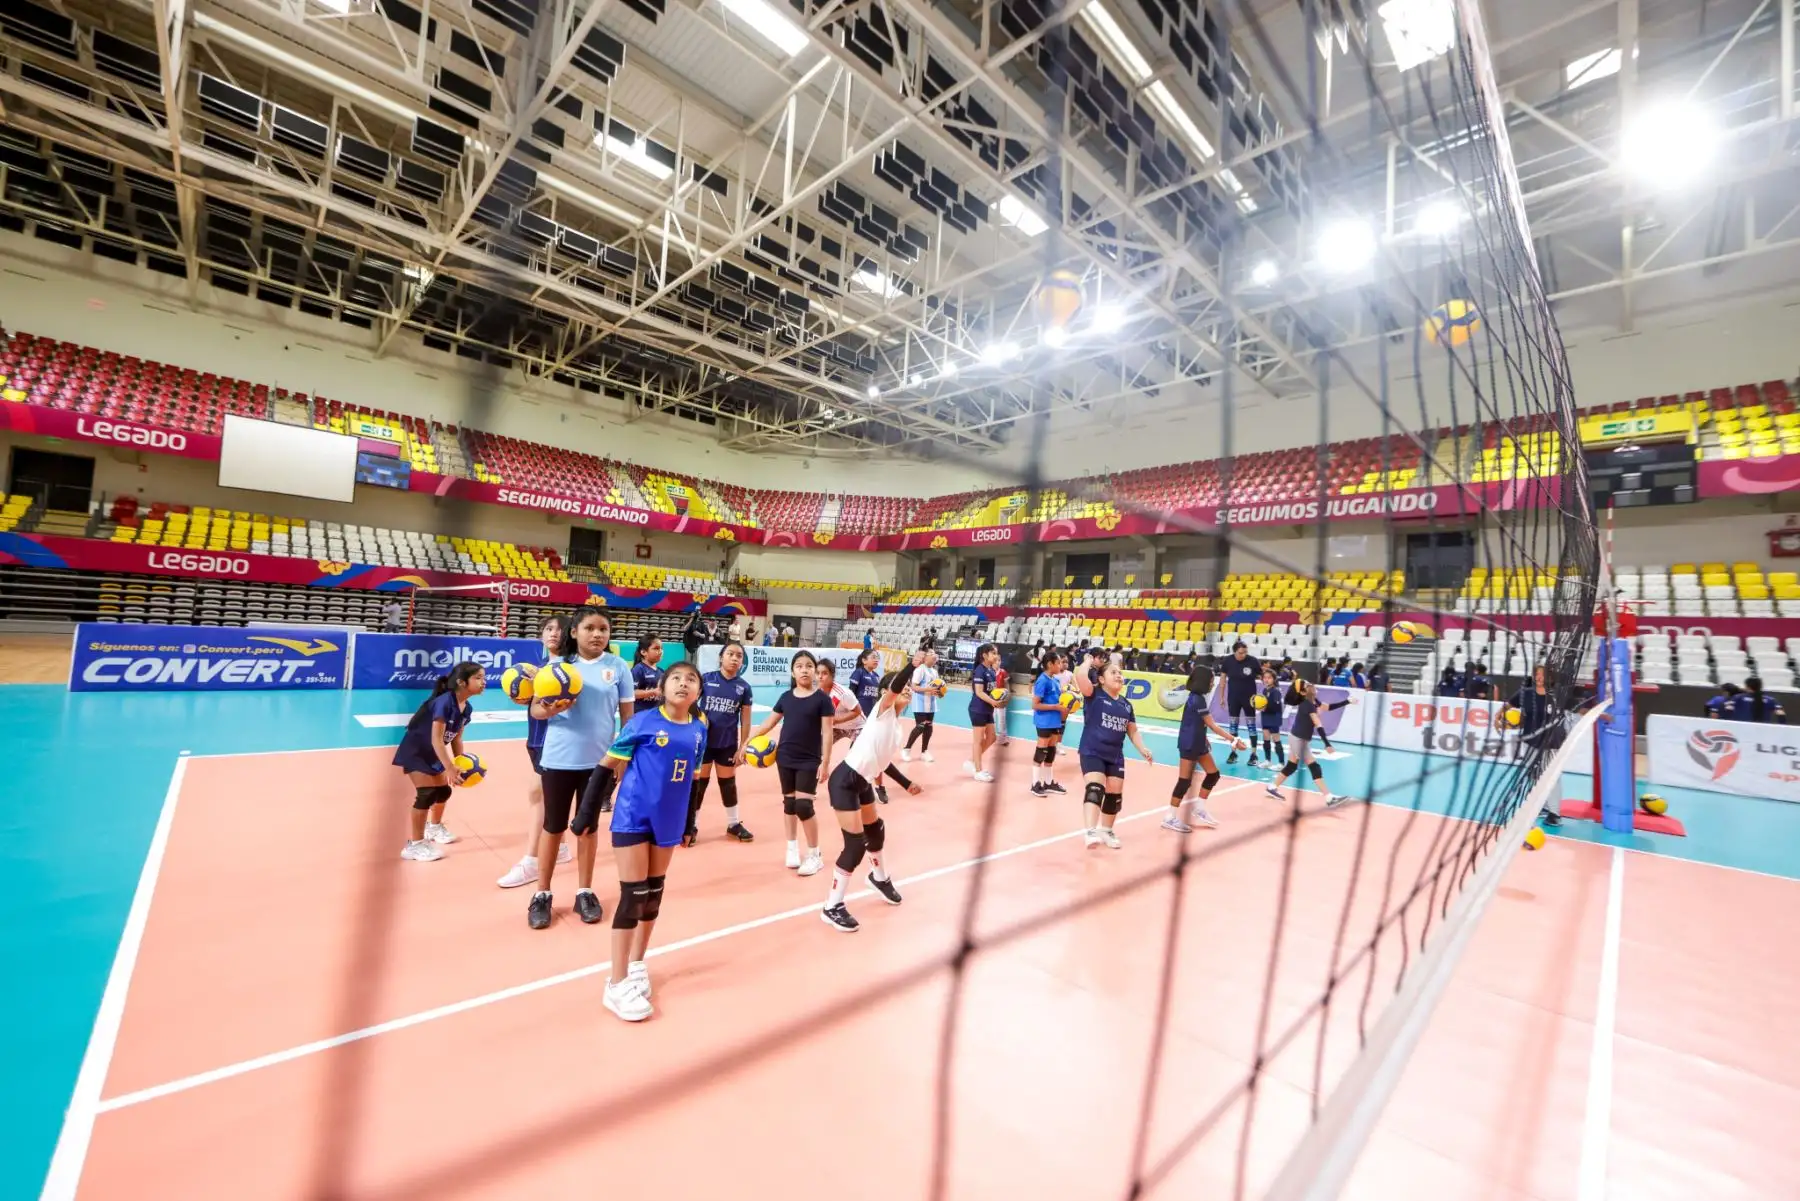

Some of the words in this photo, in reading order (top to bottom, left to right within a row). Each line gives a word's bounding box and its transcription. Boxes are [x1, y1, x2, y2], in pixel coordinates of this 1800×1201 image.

[497, 489, 582, 514] SEGUIMOS
[584, 504, 649, 525] JUGANDO
[1215, 501, 1318, 525] SEGUIMOS
[1325, 491, 1438, 517] JUGANDO
[394, 646, 512, 669] molten
[753, 656, 789, 665] GIULIANNA
[82, 657, 315, 684] CONVERT
[388, 670, 416, 682] For
[752, 664, 788, 673] BERROCAL
[1756, 743, 1800, 756] LIG
